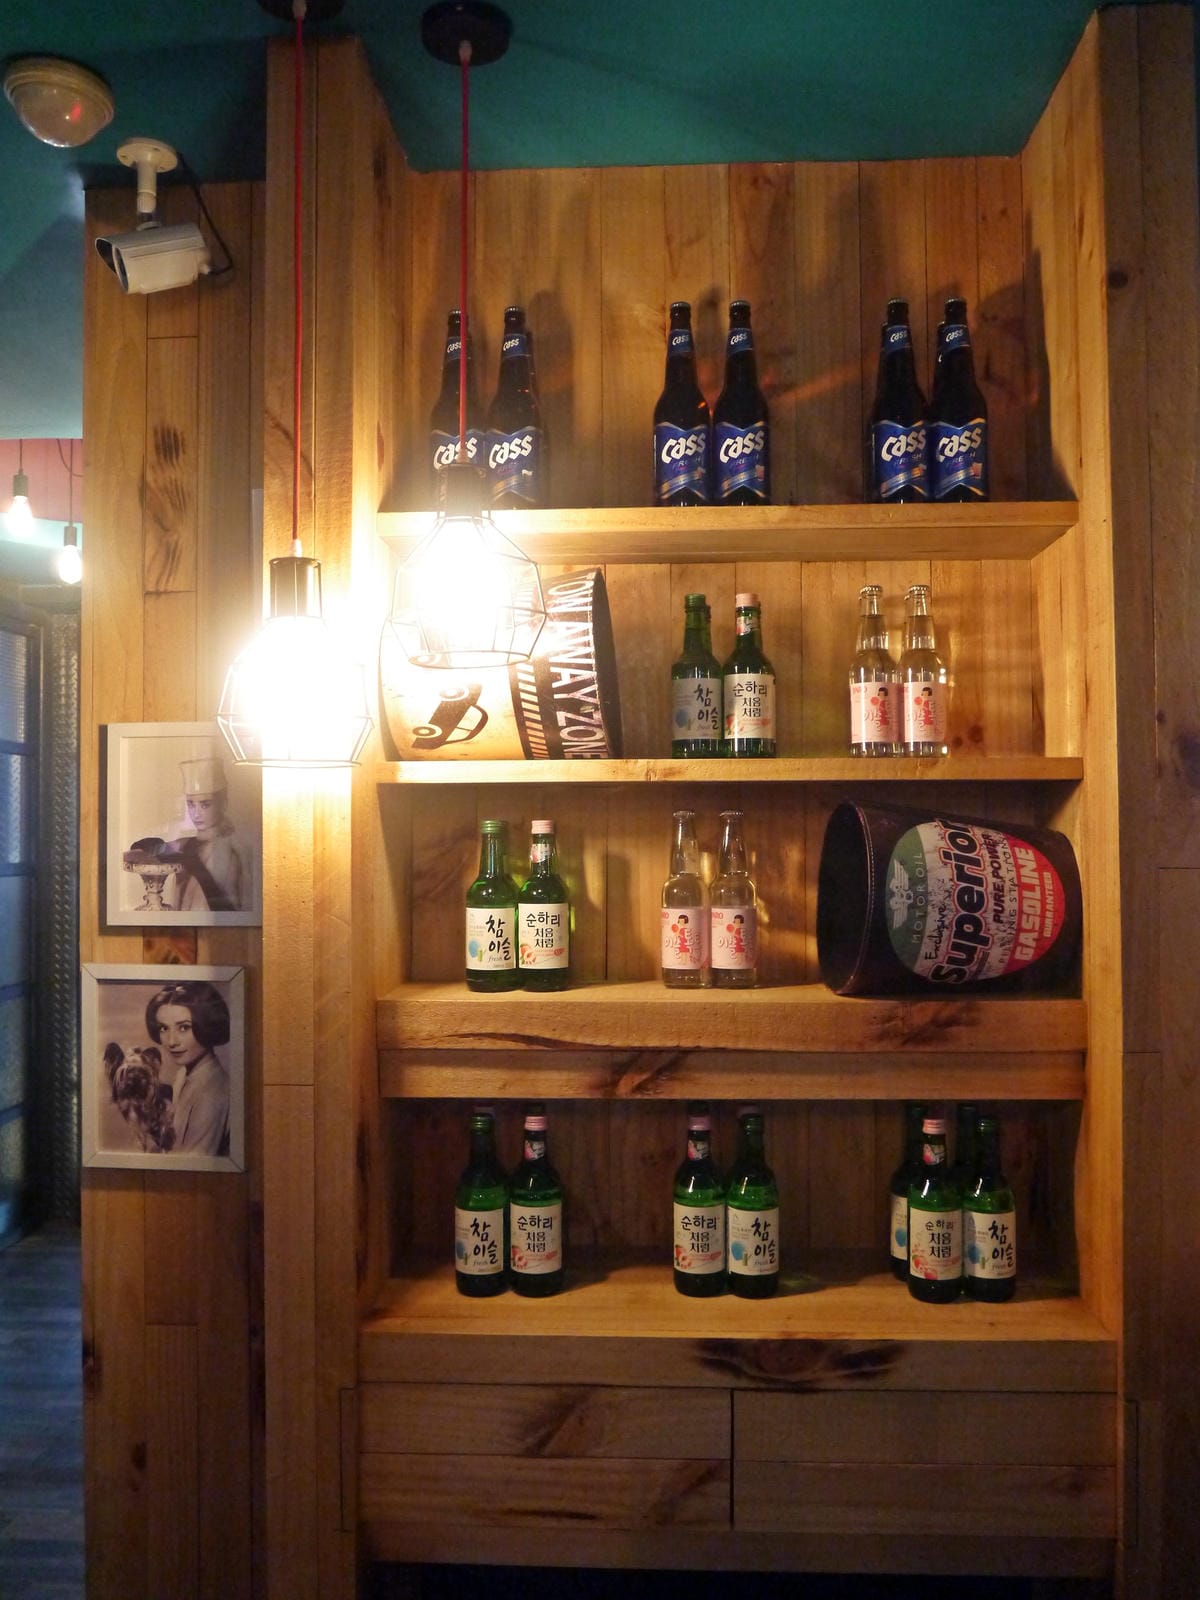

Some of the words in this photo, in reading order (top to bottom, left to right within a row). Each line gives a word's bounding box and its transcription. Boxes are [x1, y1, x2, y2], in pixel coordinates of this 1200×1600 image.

[547, 572, 597, 613] TOW
[549, 620, 601, 704] AWAY
[694, 683, 713, 706] 참
[732, 681, 767, 697] 순하리
[698, 707, 719, 730] 이슬
[913, 853, 925, 878] OIL
[982, 833, 1002, 881] POWER
[912, 883, 926, 944] MOTOR
[929, 819, 991, 983] Superior
[992, 883, 1005, 924] PURE
[1014, 847, 1041, 960] GASOLINE
[485, 914, 506, 938] 참
[526, 912, 560, 928] 순하리
[924, 904, 947, 960] Exclusive
[488, 937, 511, 961] 이슬
[470, 1217, 491, 1242] 참
[517, 1215, 553, 1231] 순하리
[681, 1215, 717, 1231] 순하리
[751, 1217, 771, 1242] 참
[925, 1219, 954, 1231] 순하리
[988, 1220, 1009, 1245] 참
[473, 1240, 498, 1264] 이슬
[754, 1239, 777, 1264] 이슬
[992, 1242, 1014, 1267] 이슬
